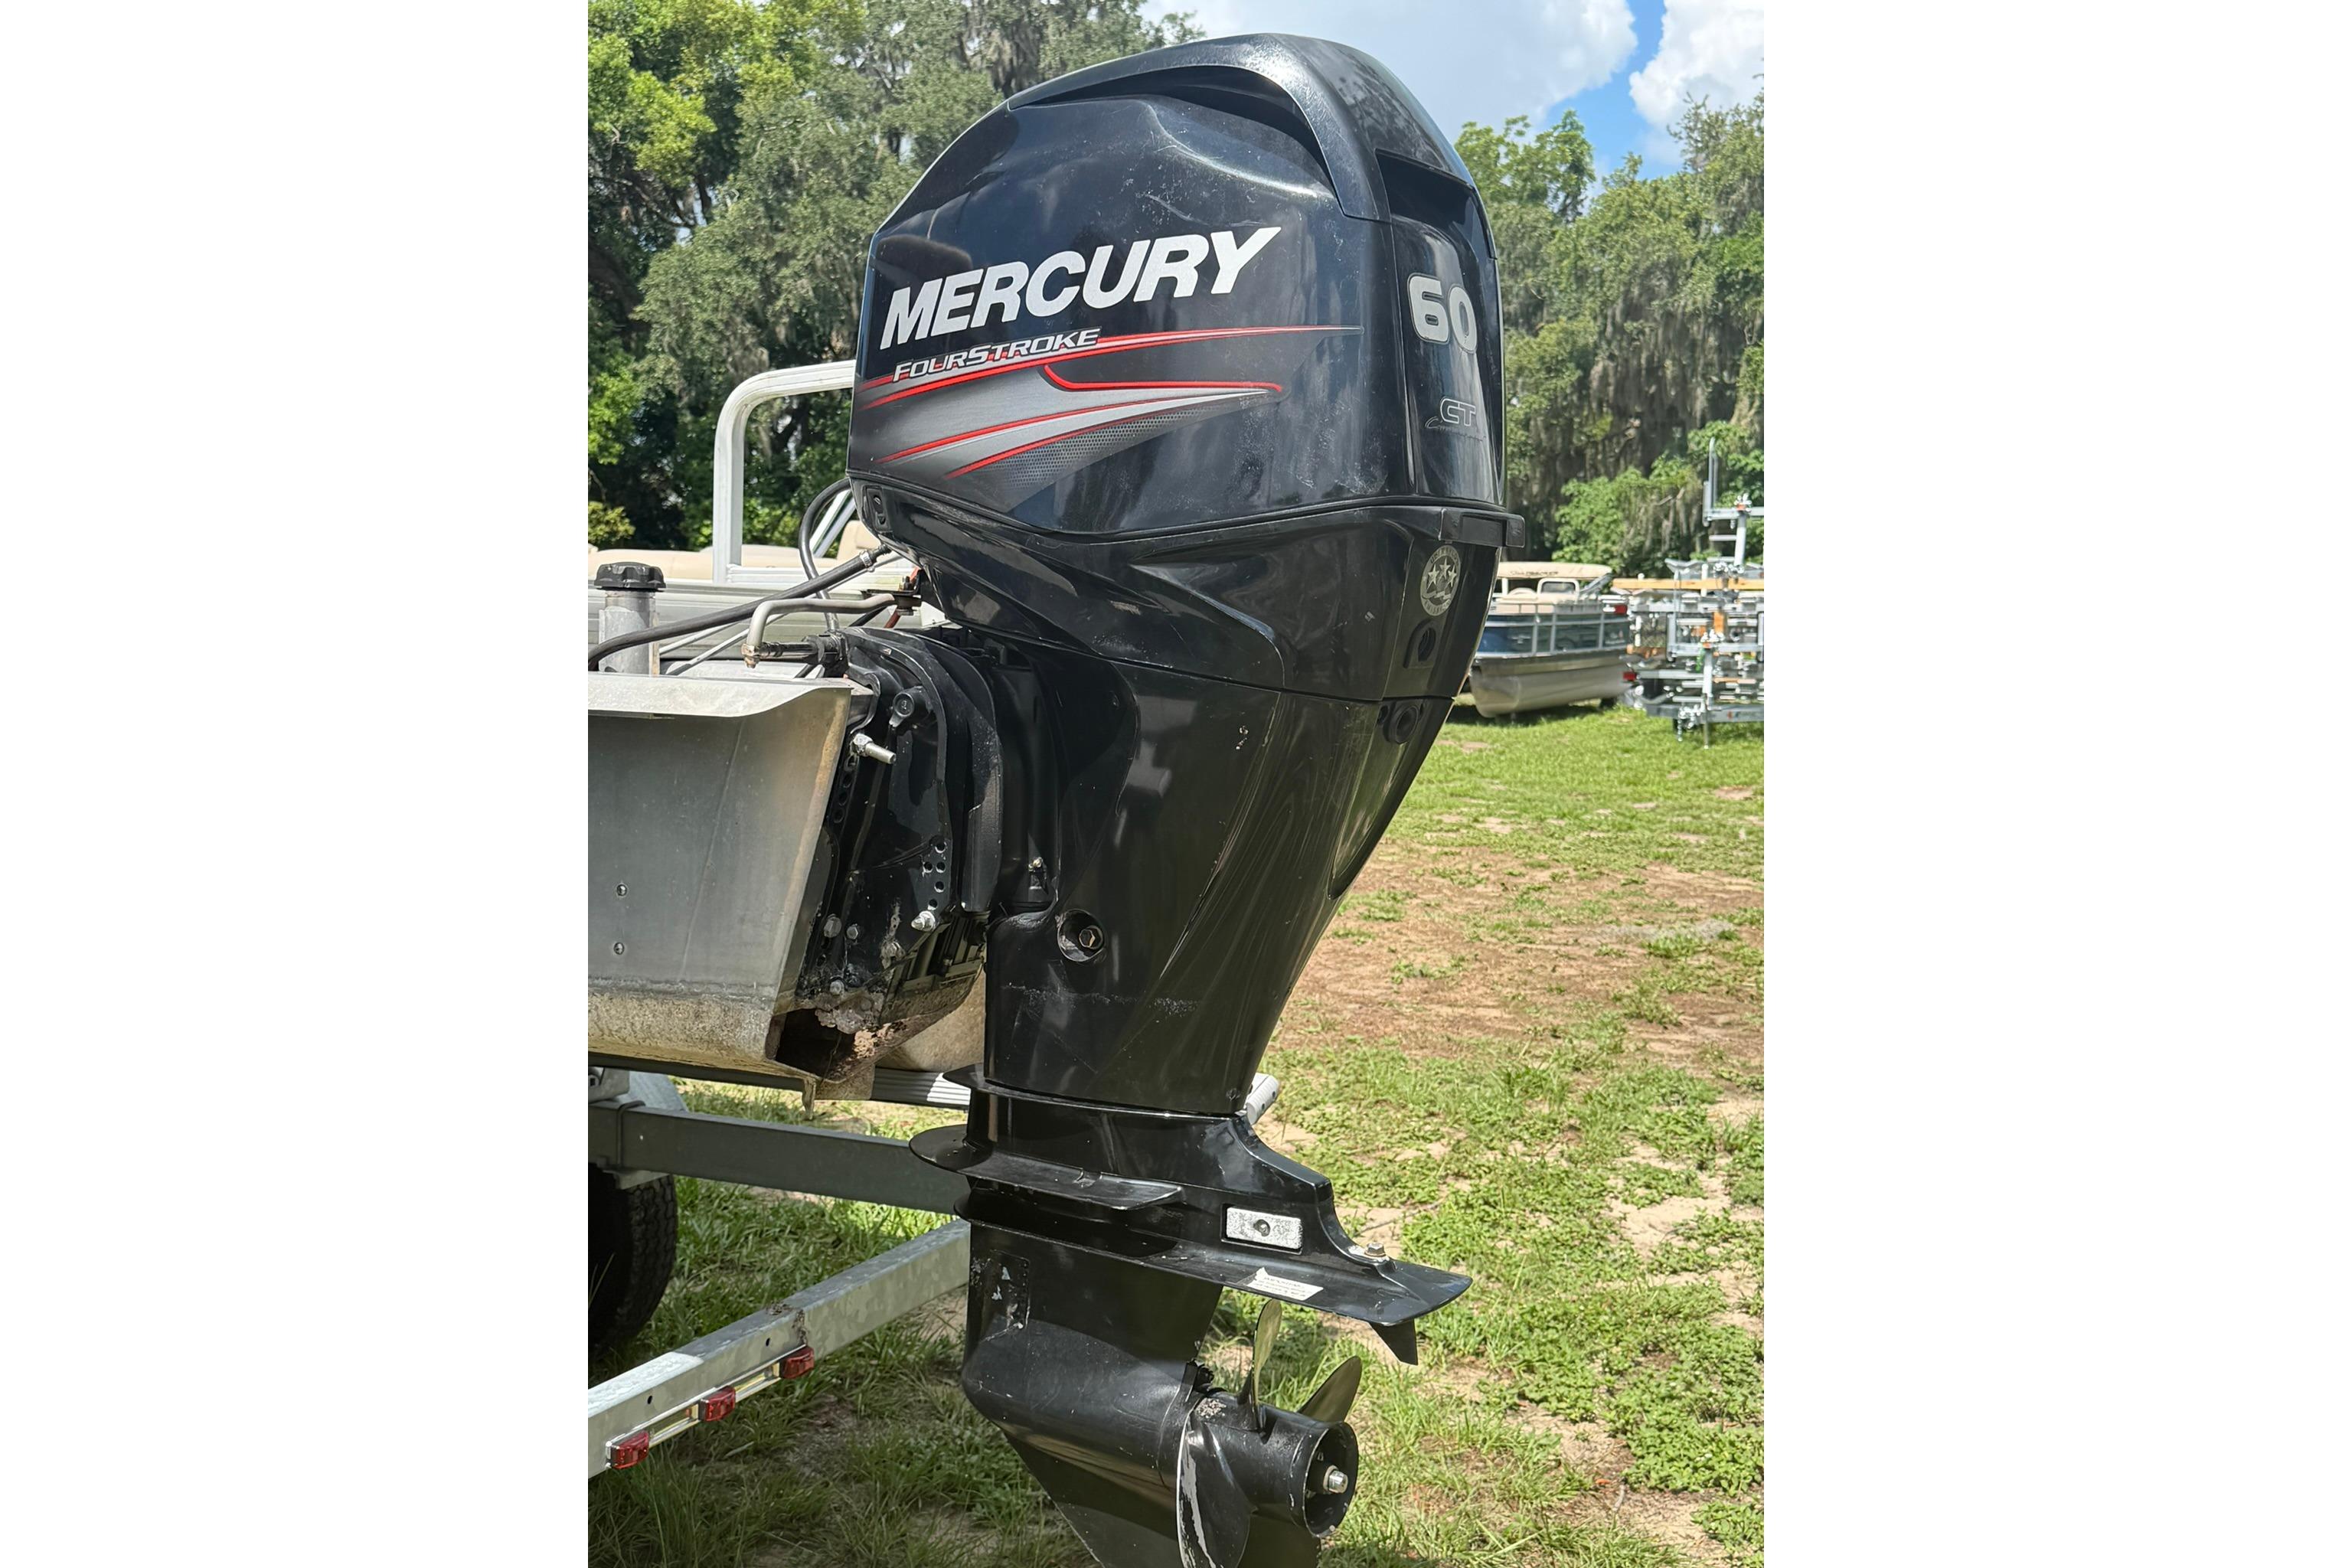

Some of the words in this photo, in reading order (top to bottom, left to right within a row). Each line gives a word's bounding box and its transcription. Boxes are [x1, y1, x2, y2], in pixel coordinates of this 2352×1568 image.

[880, 227, 1282, 350] MERCURY
[1408, 274, 1478, 351] 60
[893, 328, 1101, 383] FOURSTROKE
